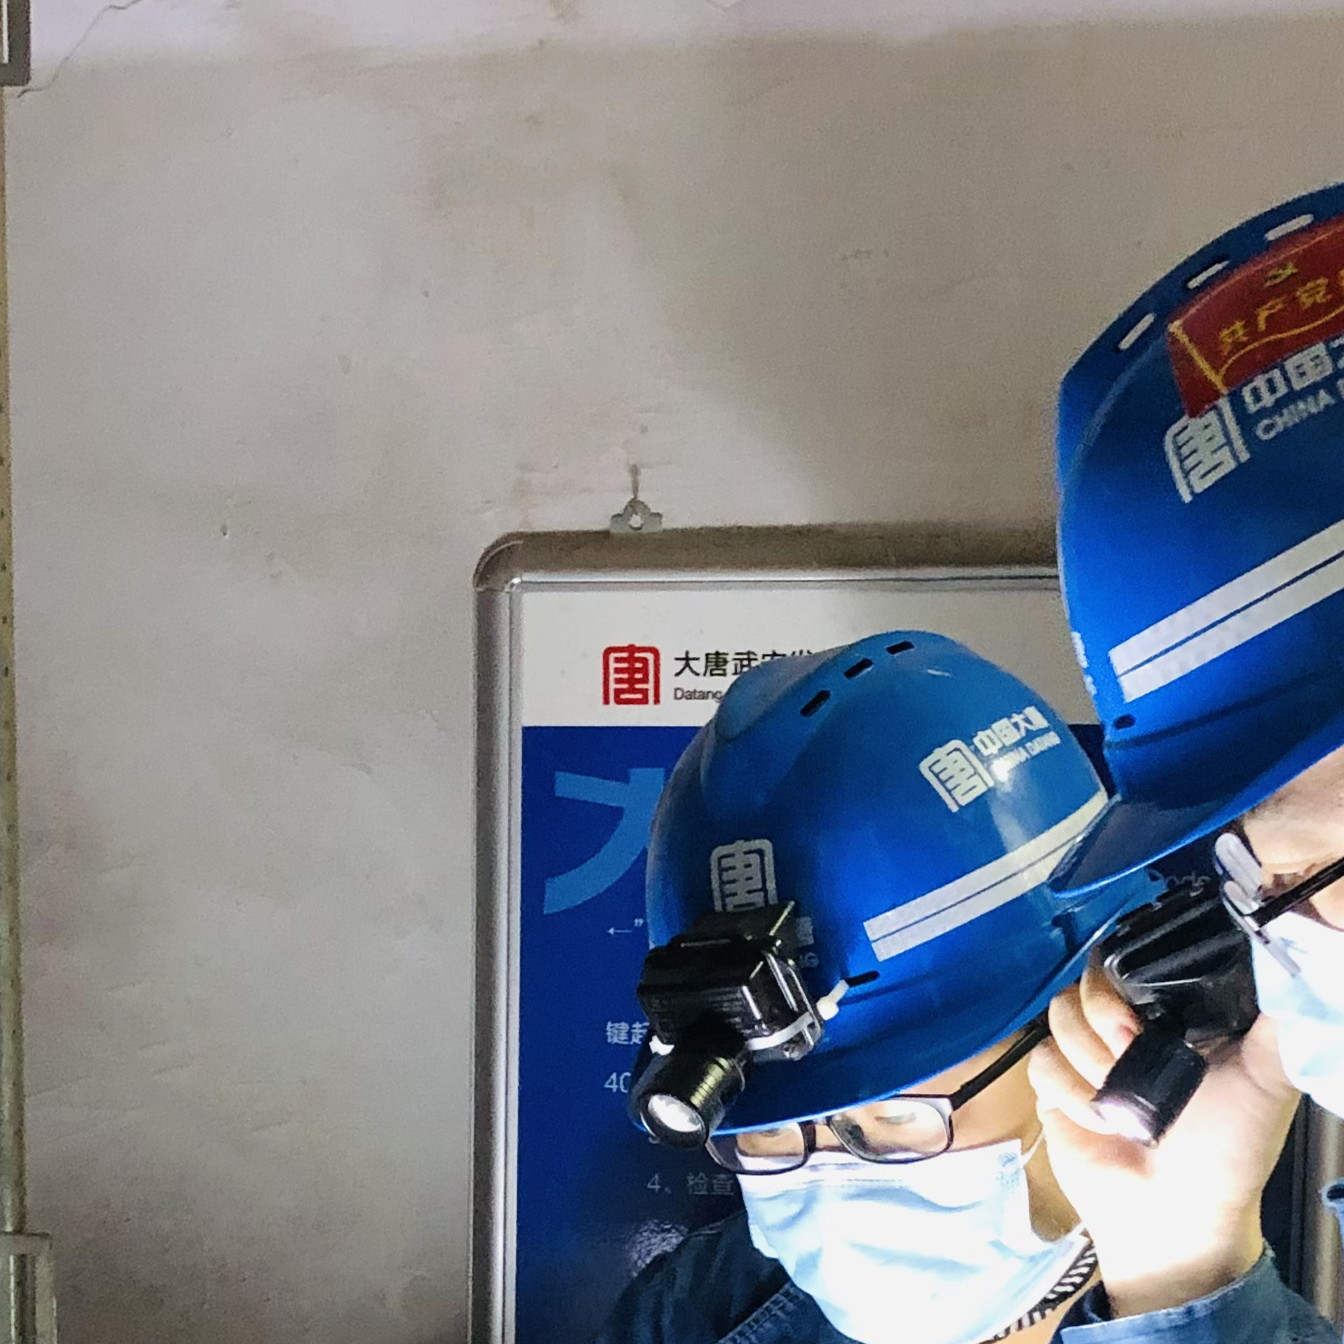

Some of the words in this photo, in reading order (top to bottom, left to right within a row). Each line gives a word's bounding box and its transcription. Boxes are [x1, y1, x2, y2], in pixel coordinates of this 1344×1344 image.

[1255, 389, 1335, 440] CHINA
[673, 650, 813, 677] 大唐武
